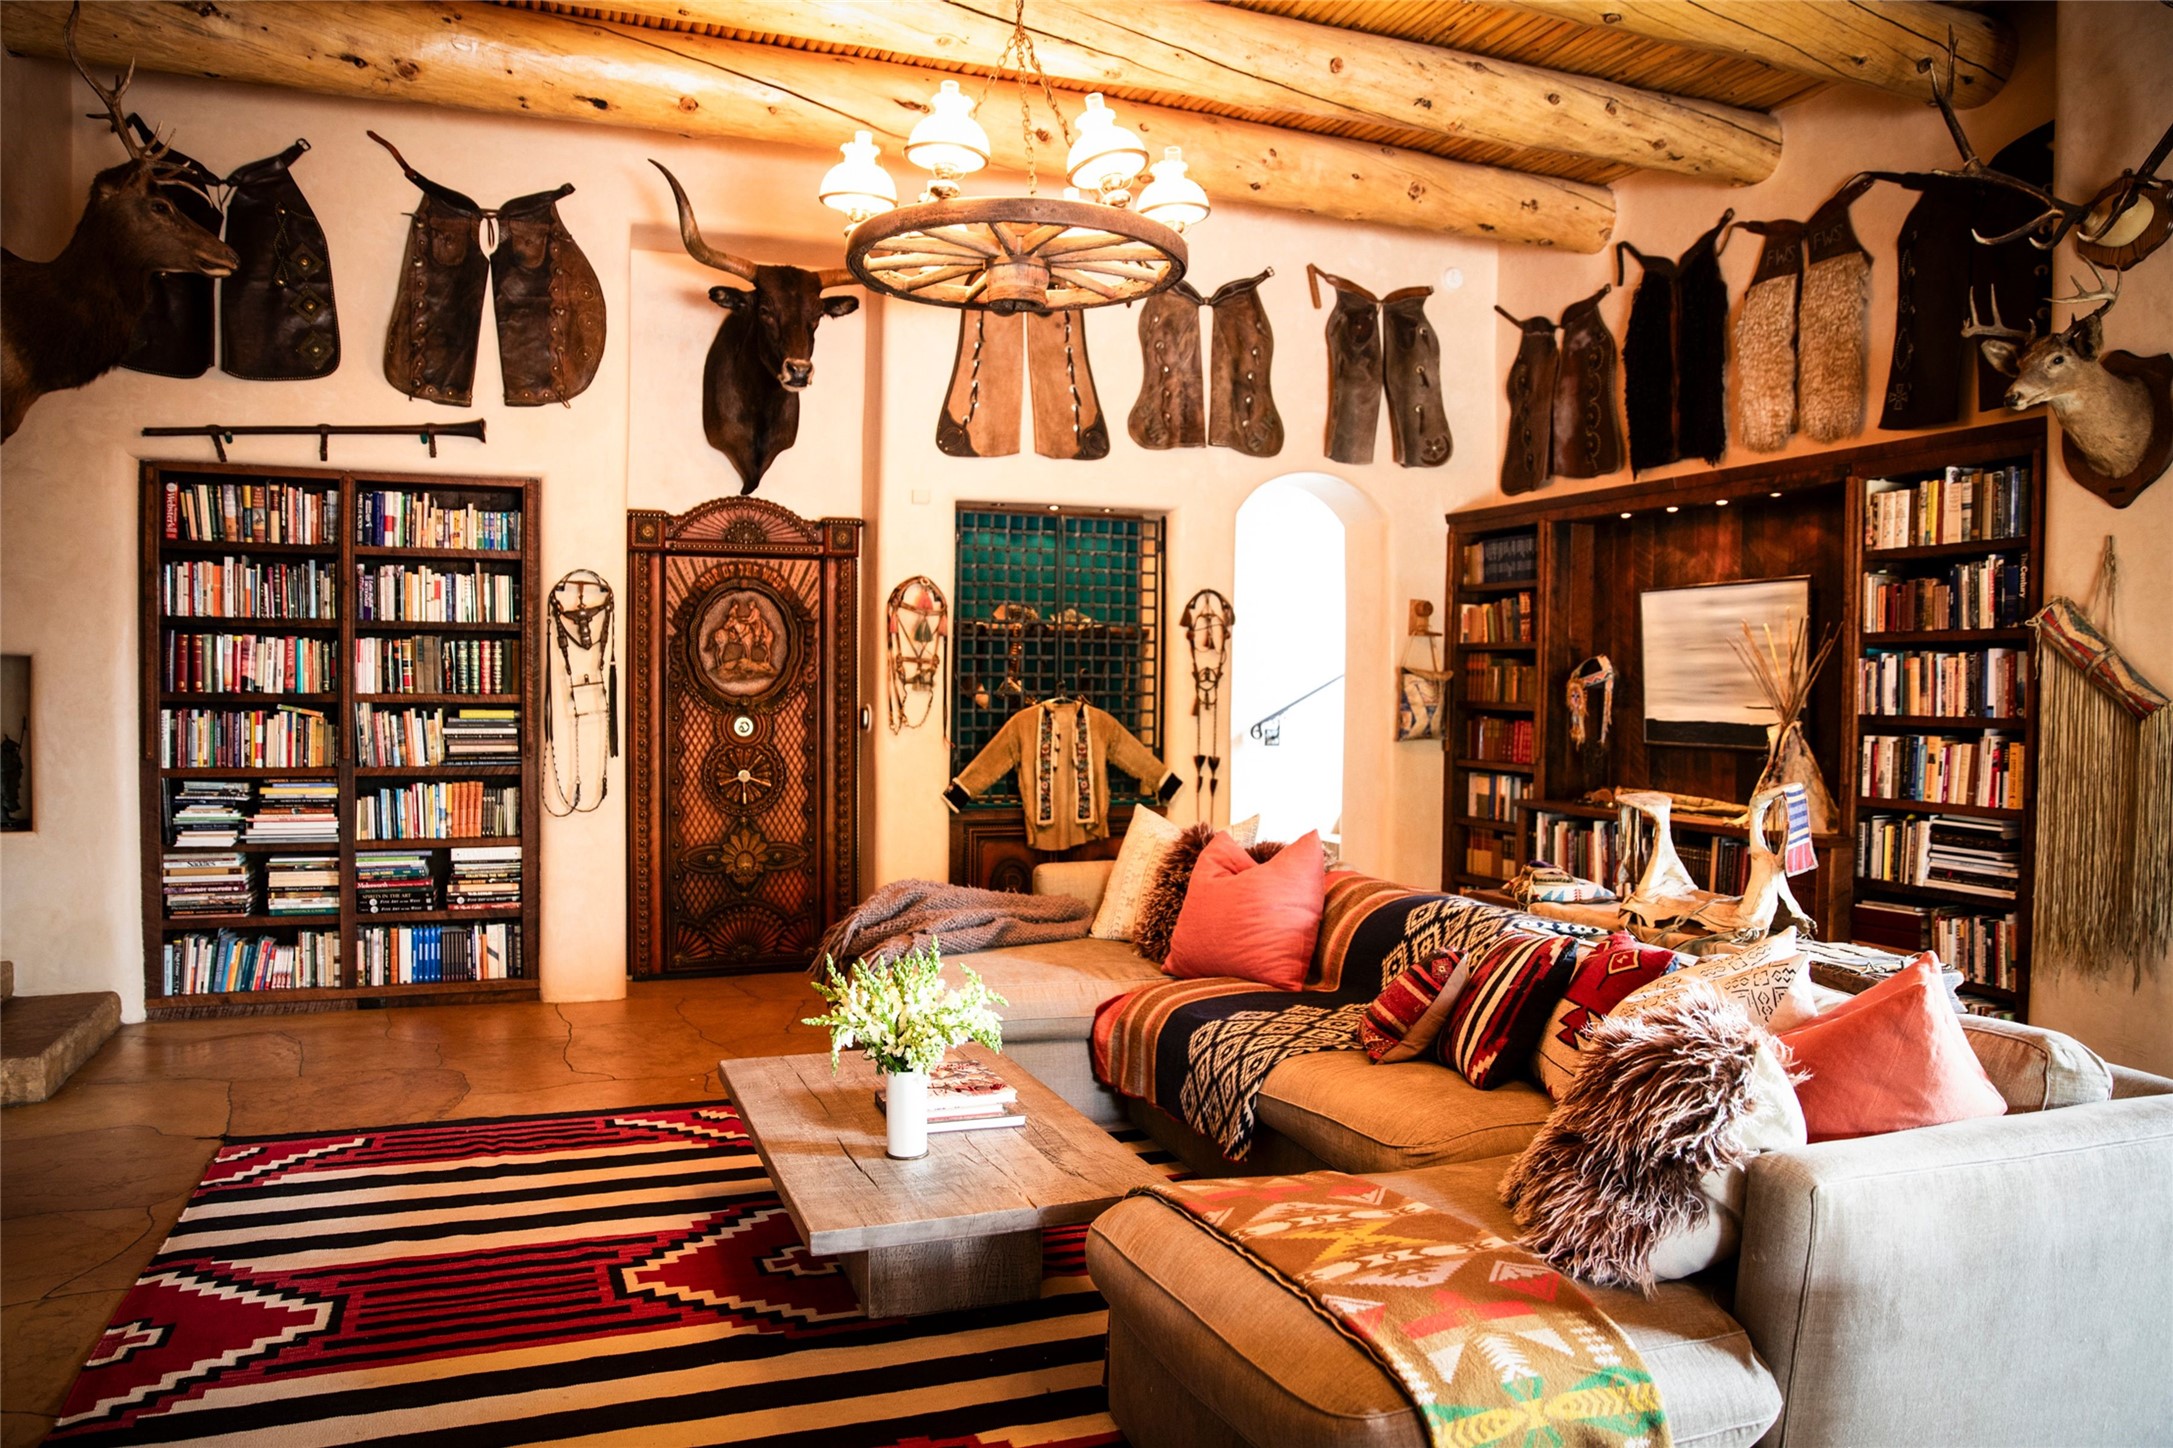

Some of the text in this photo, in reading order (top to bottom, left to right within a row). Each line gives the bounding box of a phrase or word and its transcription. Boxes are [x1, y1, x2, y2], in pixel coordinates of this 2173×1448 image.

[166, 492, 176, 528] Webster's
[721, 564, 735, 578] OF
[2018, 565, 2029, 598] Century
